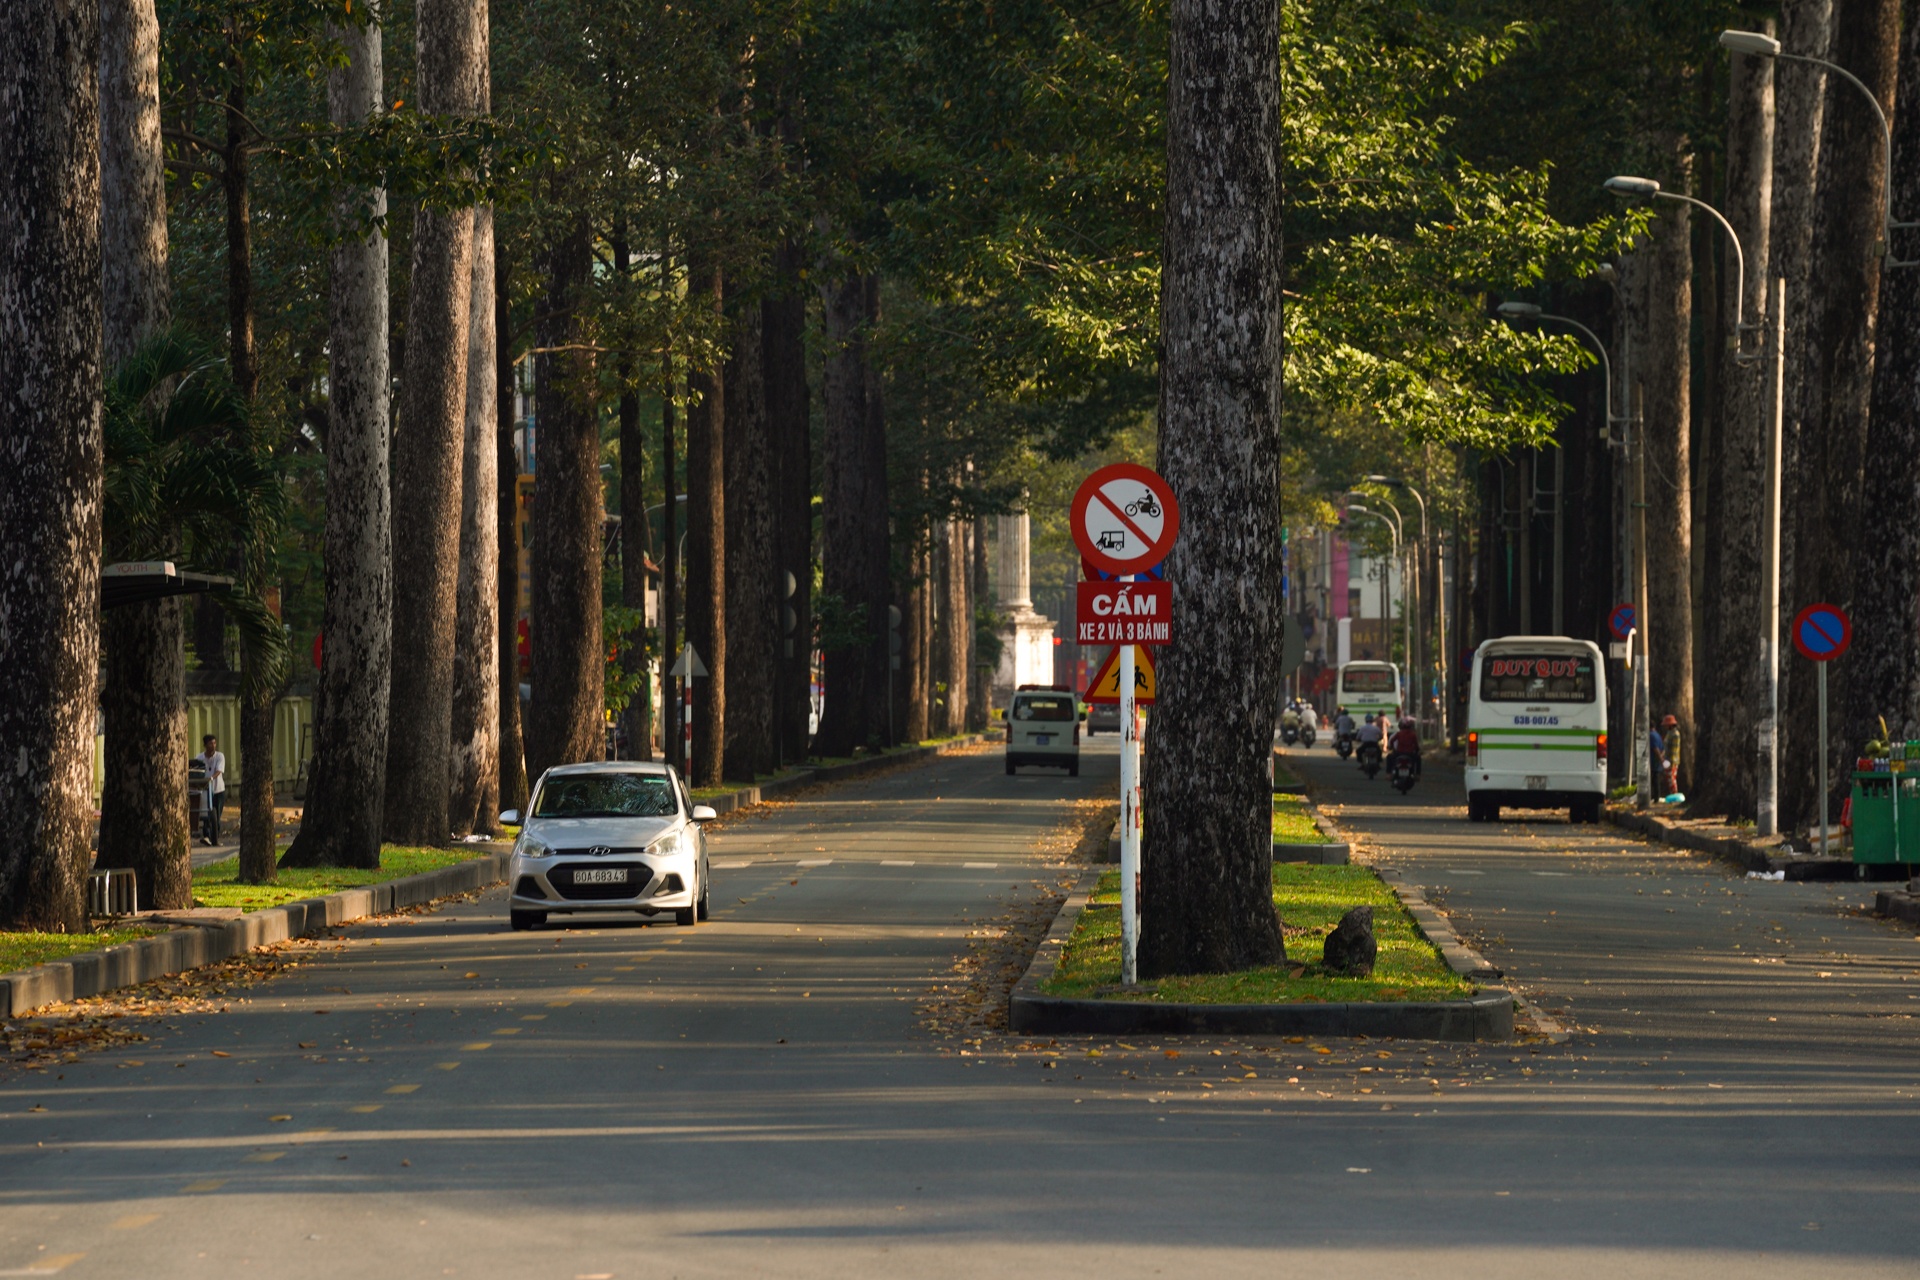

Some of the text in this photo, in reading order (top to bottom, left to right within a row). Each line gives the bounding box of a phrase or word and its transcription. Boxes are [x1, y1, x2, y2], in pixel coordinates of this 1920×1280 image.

[116, 563, 147, 573] YOUTH
[1092, 585, 1157, 616] CẤM
[1079, 618, 1169, 640] XE 2 VÀ 3 BÁNH
[1491, 657, 1580, 677] DUY QUÝ
